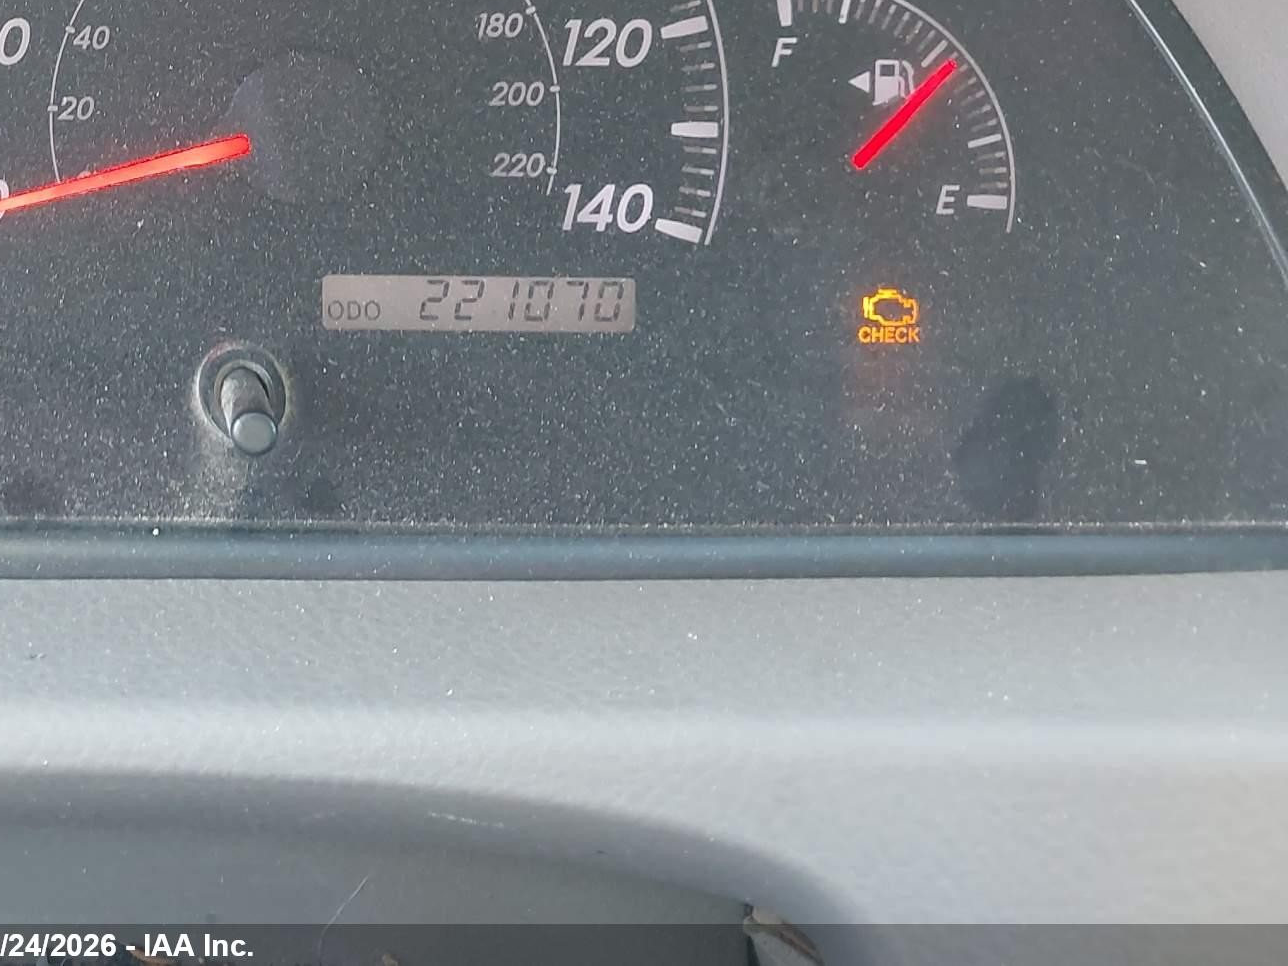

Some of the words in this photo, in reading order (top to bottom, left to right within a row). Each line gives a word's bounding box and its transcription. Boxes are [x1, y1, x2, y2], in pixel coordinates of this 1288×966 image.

[477, 12, 524, 38] 180
[73, 26, 110, 51] 40
[562, 18, 653, 68] 120
[771, 37, 798, 67] F
[489, 81, 544, 106] 200
[58, 97, 94, 120] 20
[490, 152, 545, 177] 220
[562, 184, 654, 233] 140
[936, 185, 960, 215] E
[327, 300, 381, 320] ODO
[419, 279, 624, 322] 221070
[858, 327, 920, 344] CHECK
